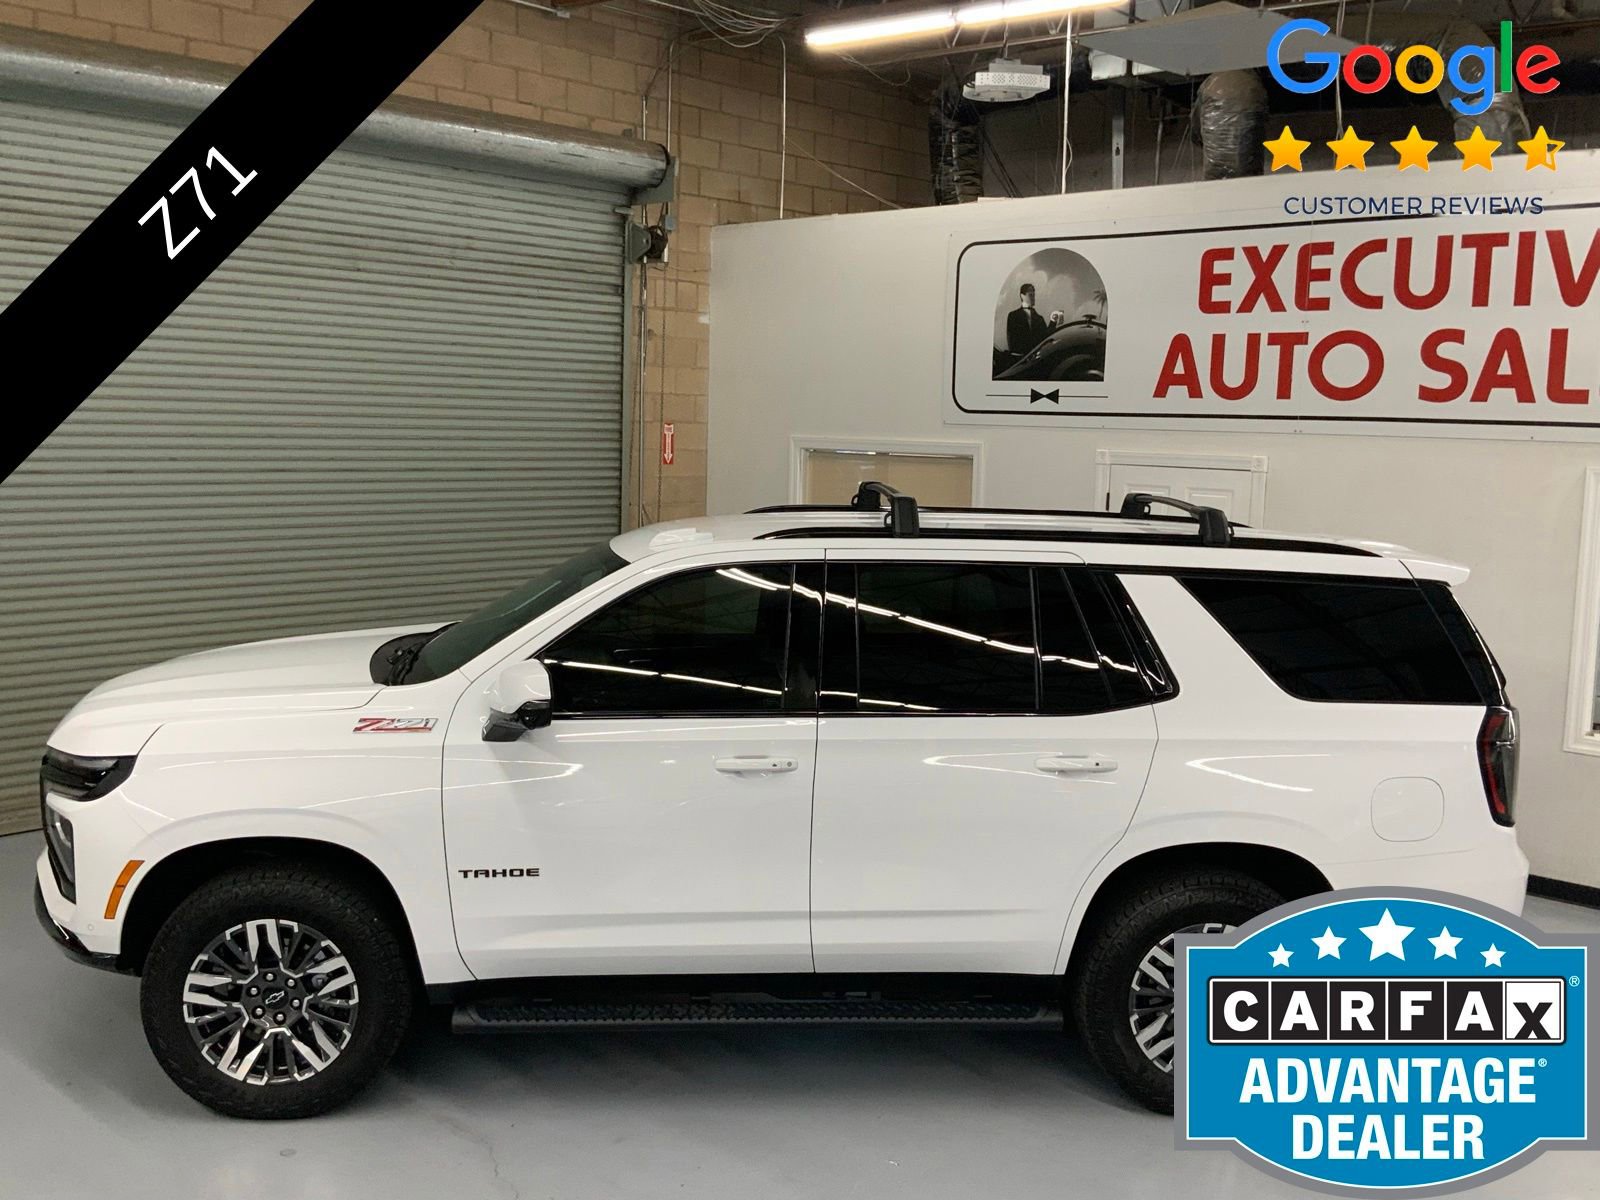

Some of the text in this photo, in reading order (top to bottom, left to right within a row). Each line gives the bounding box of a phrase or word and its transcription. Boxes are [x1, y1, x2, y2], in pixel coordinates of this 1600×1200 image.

[1198, 228, 1600, 314] EXECUTIV
[1153, 327, 1600, 405] AUTO SAL
[353, 718, 438, 733] Z71
[458, 868, 540, 878] TAHOE
